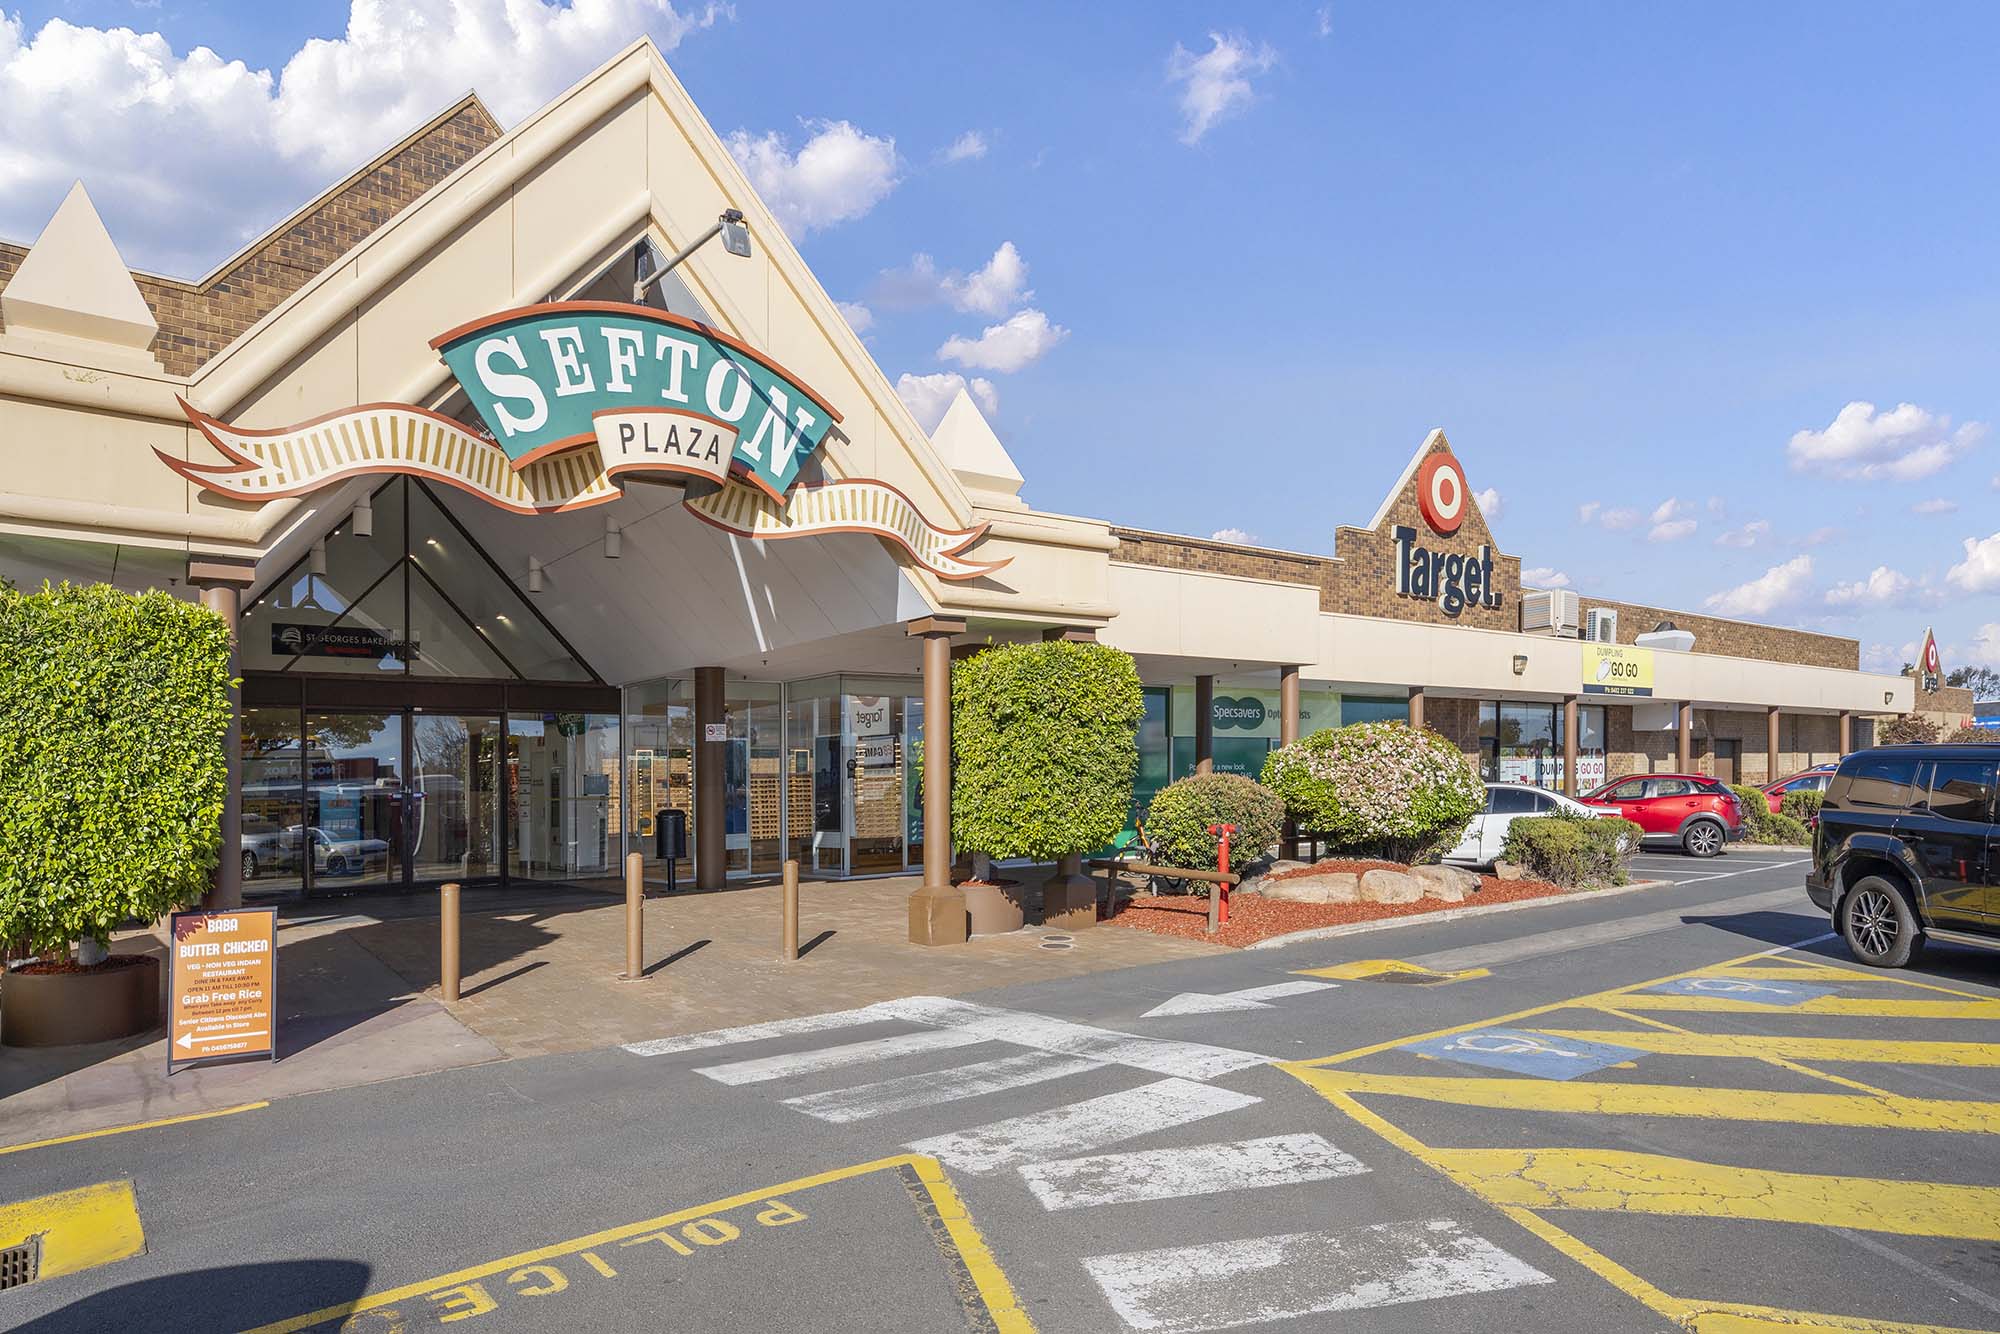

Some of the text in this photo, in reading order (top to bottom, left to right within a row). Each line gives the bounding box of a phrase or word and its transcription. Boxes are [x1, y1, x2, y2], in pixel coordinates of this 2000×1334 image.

[474, 326, 816, 478] SEFTON
[619, 423, 719, 464] PLAZA
[1596, 647, 1623, 658] DUMPLING
[1611, 662, 1638, 678] GO GO
[1213, 705, 1261, 720] Specsavers
[1581, 763, 1591, 775] GO
[1593, 763, 1604, 774] GO
[207, 919, 238, 933] BABA
[180, 940, 268, 958] BUTTER CHICKEN
[206, 962, 222, 970] NON
[222, 960, 236, 968] VEG
[237, 959, 261, 967] INDIAN
[202, 969, 246, 978] RESTAURANT
[182, 989, 262, 1005] Grab Free Rice
[178, 1017, 199, 1026] Senior
[225, 1013, 253, 1022] Discount
[196, 1024, 225, 1032] Available
[426, 1200, 808, 1324] POLICE
